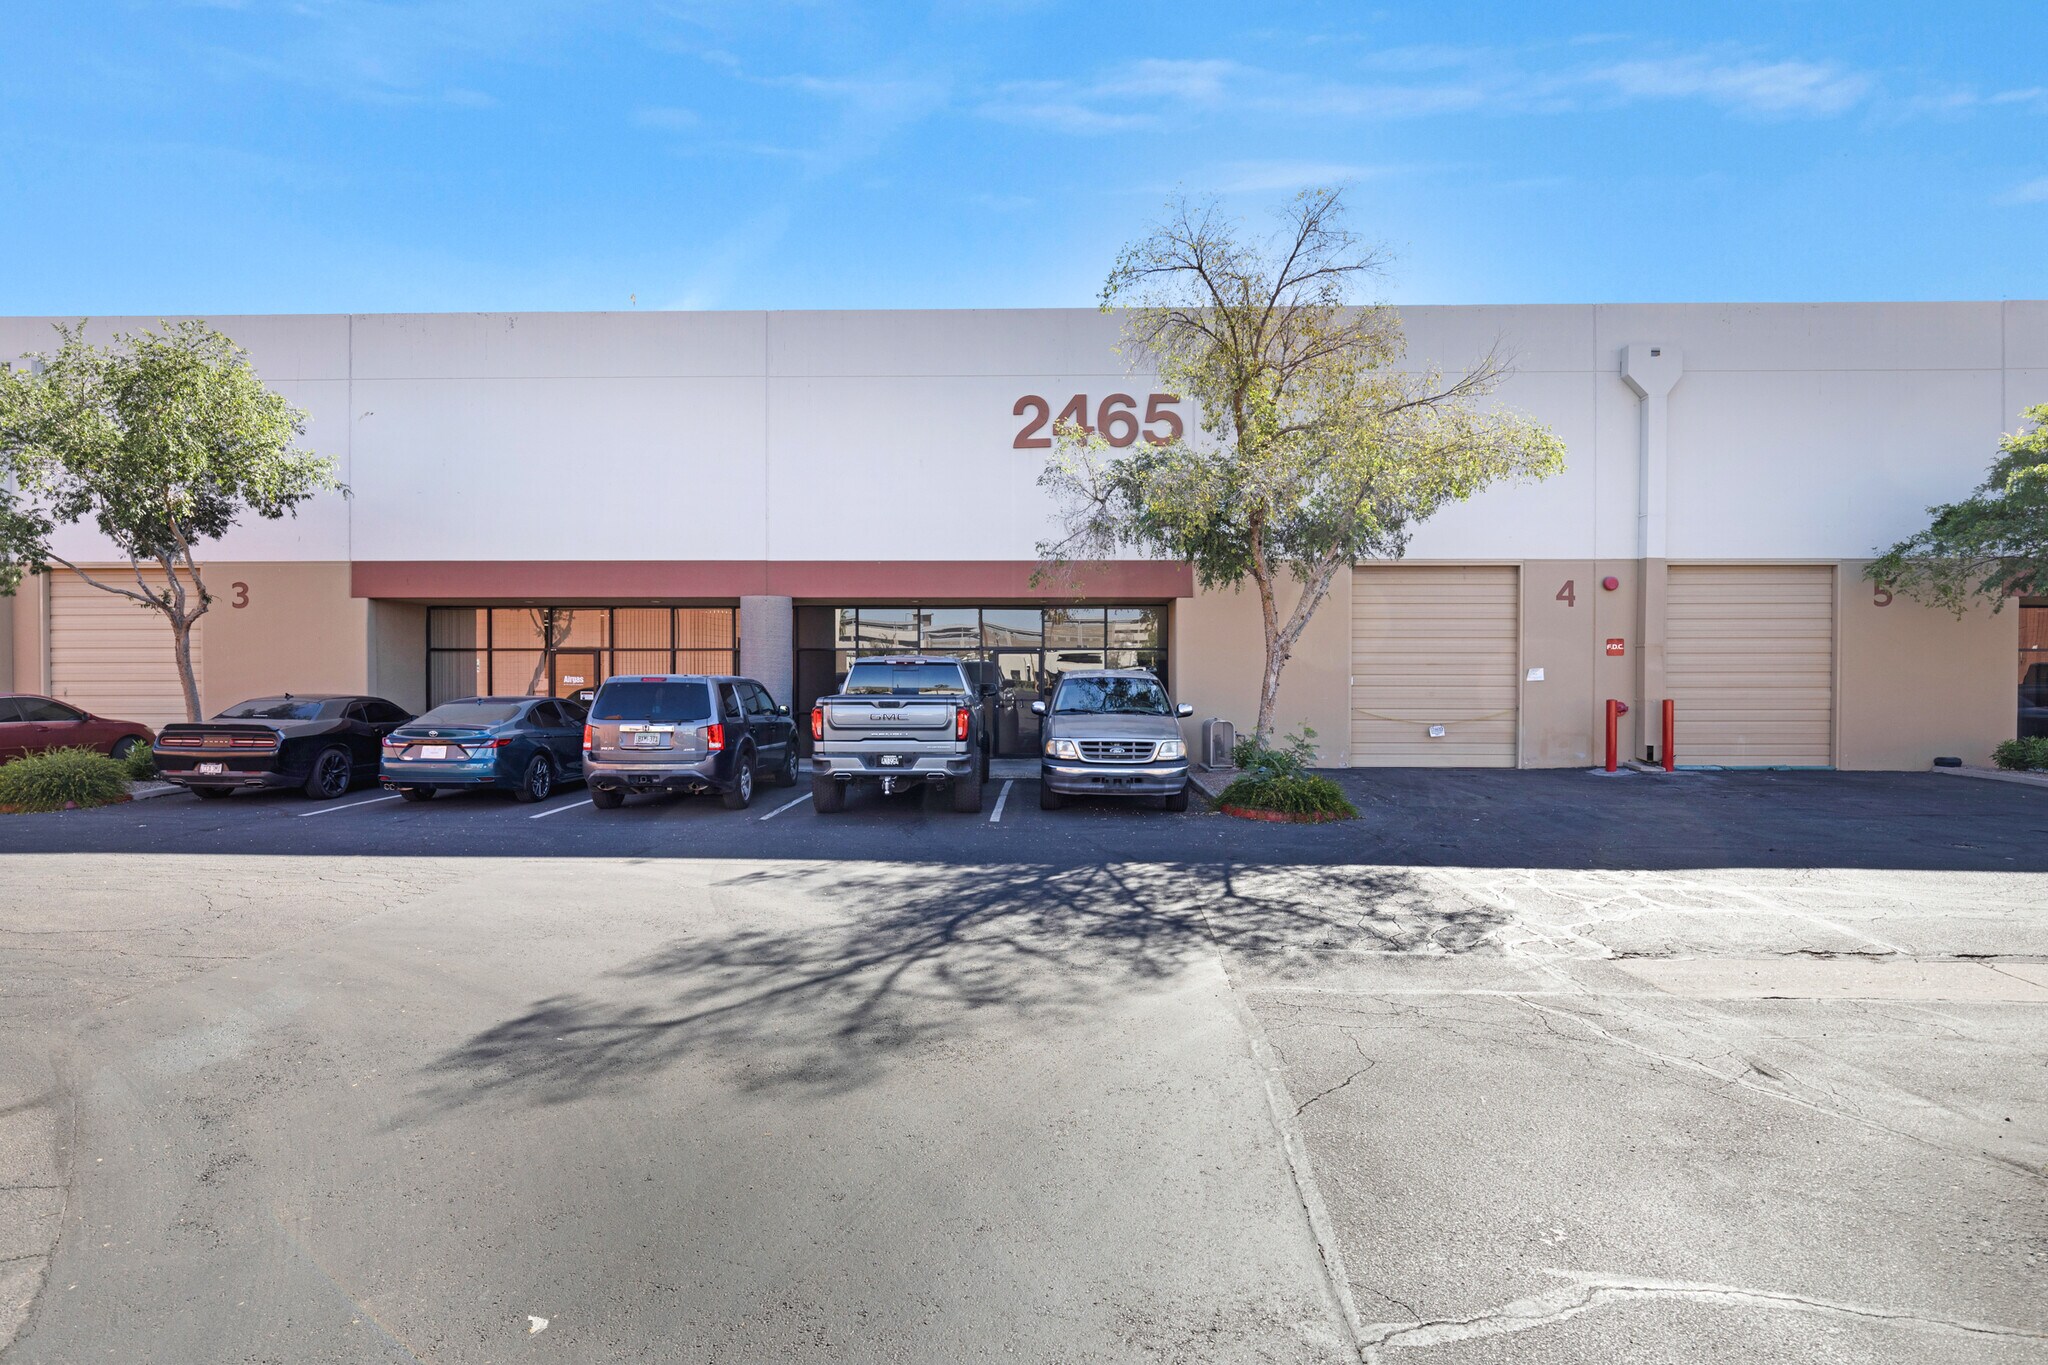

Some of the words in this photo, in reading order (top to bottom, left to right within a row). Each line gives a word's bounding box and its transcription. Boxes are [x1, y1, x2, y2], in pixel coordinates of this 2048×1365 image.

[1013, 393, 1184, 449] 2465
[231, 582, 249, 609] 3
[1556, 580, 1576, 607] 4
[1873, 579, 1892, 607] 5
[563, 675, 584, 684] Airgas
[870, 713, 910, 721] GMC
